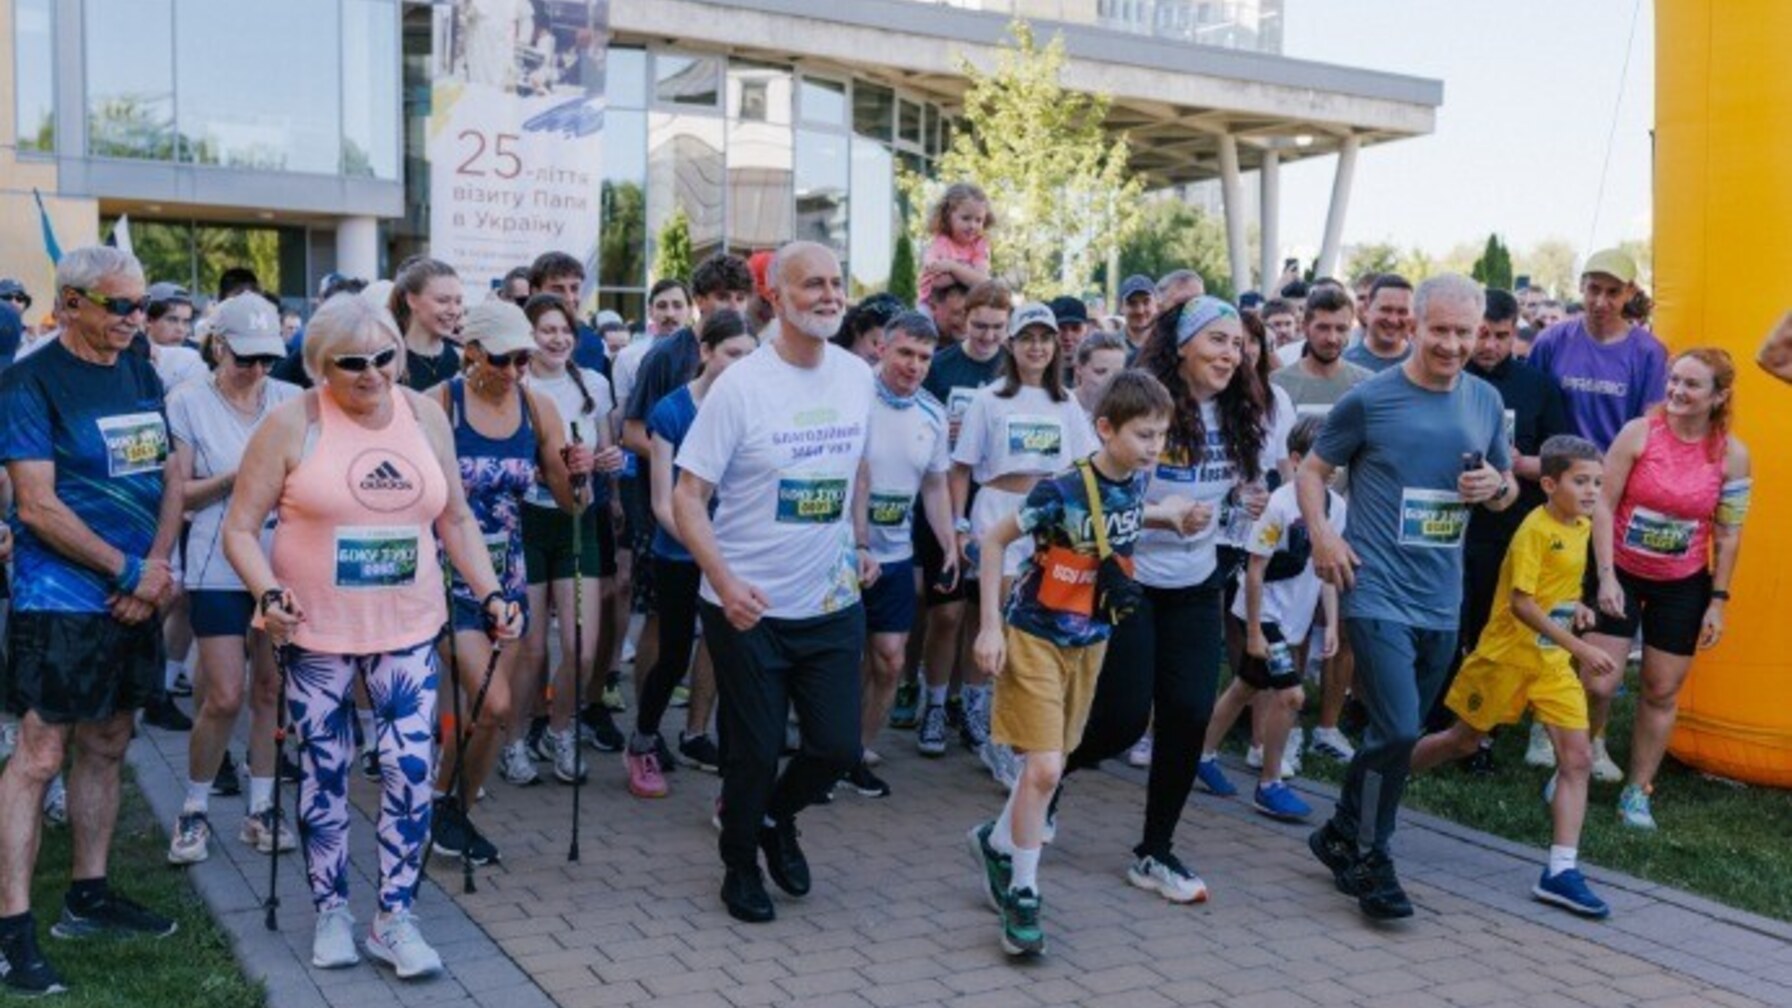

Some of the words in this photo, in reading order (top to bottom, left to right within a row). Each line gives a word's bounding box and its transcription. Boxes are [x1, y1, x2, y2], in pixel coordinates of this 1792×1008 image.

[456, 130, 588, 184] 25-ліття
[453, 184, 525, 209] візиту
[533, 189, 587, 211] Папи
[453, 213, 465, 228] в
[475, 211, 566, 237] Україну
[360, 479, 413, 490] adidas
